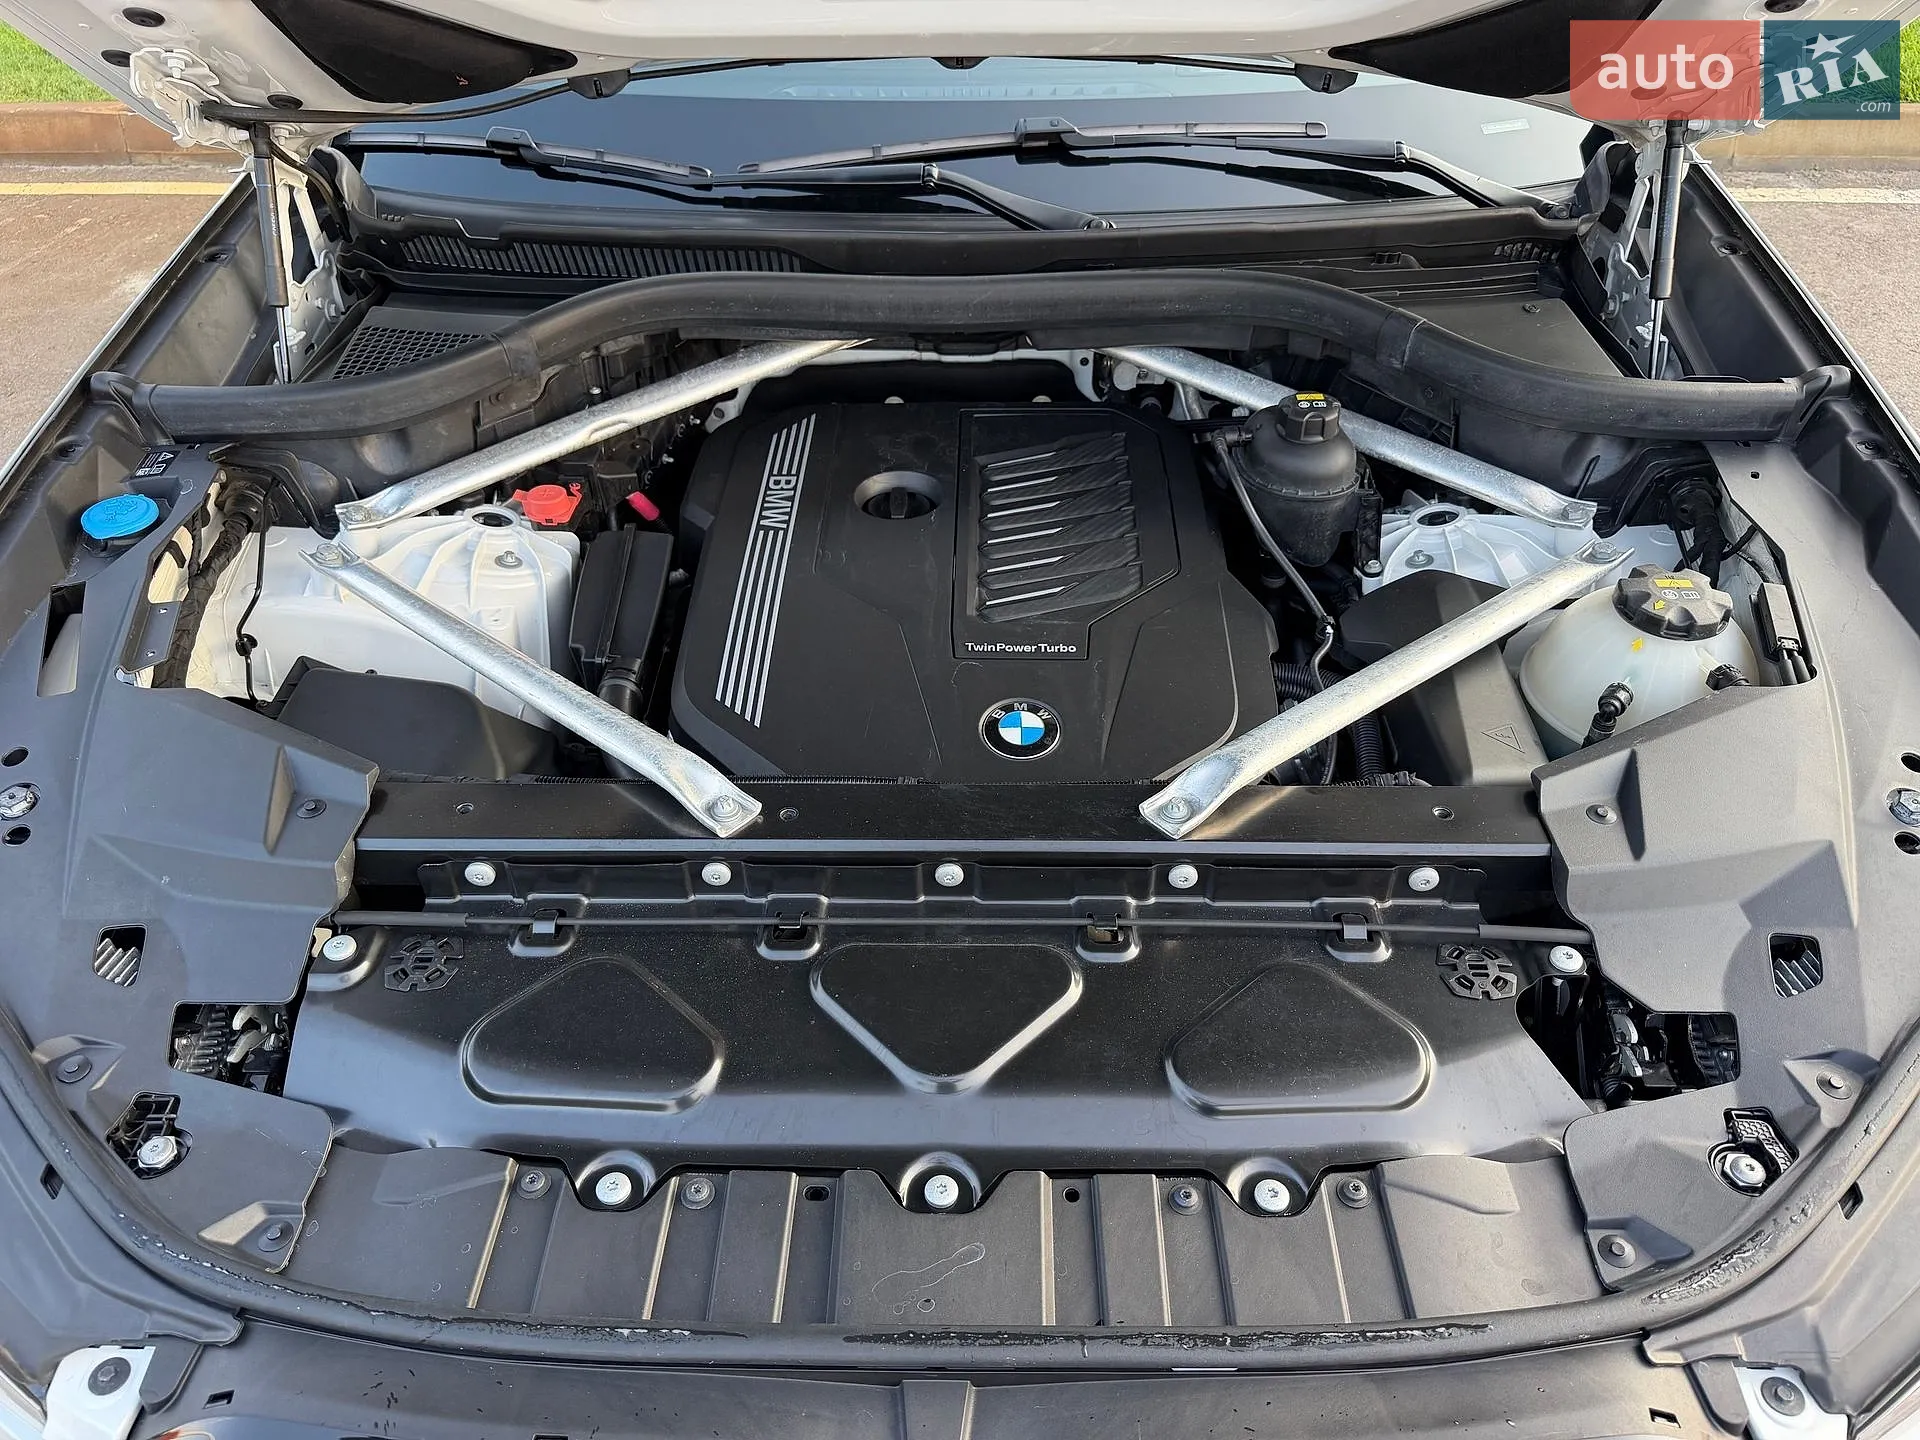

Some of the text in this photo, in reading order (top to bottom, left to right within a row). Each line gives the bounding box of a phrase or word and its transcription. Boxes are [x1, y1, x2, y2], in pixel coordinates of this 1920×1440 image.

[759, 475, 797, 528] BMW
[1038, 643, 1077, 653] Turbo
[991, 702, 1052, 719] BMW
